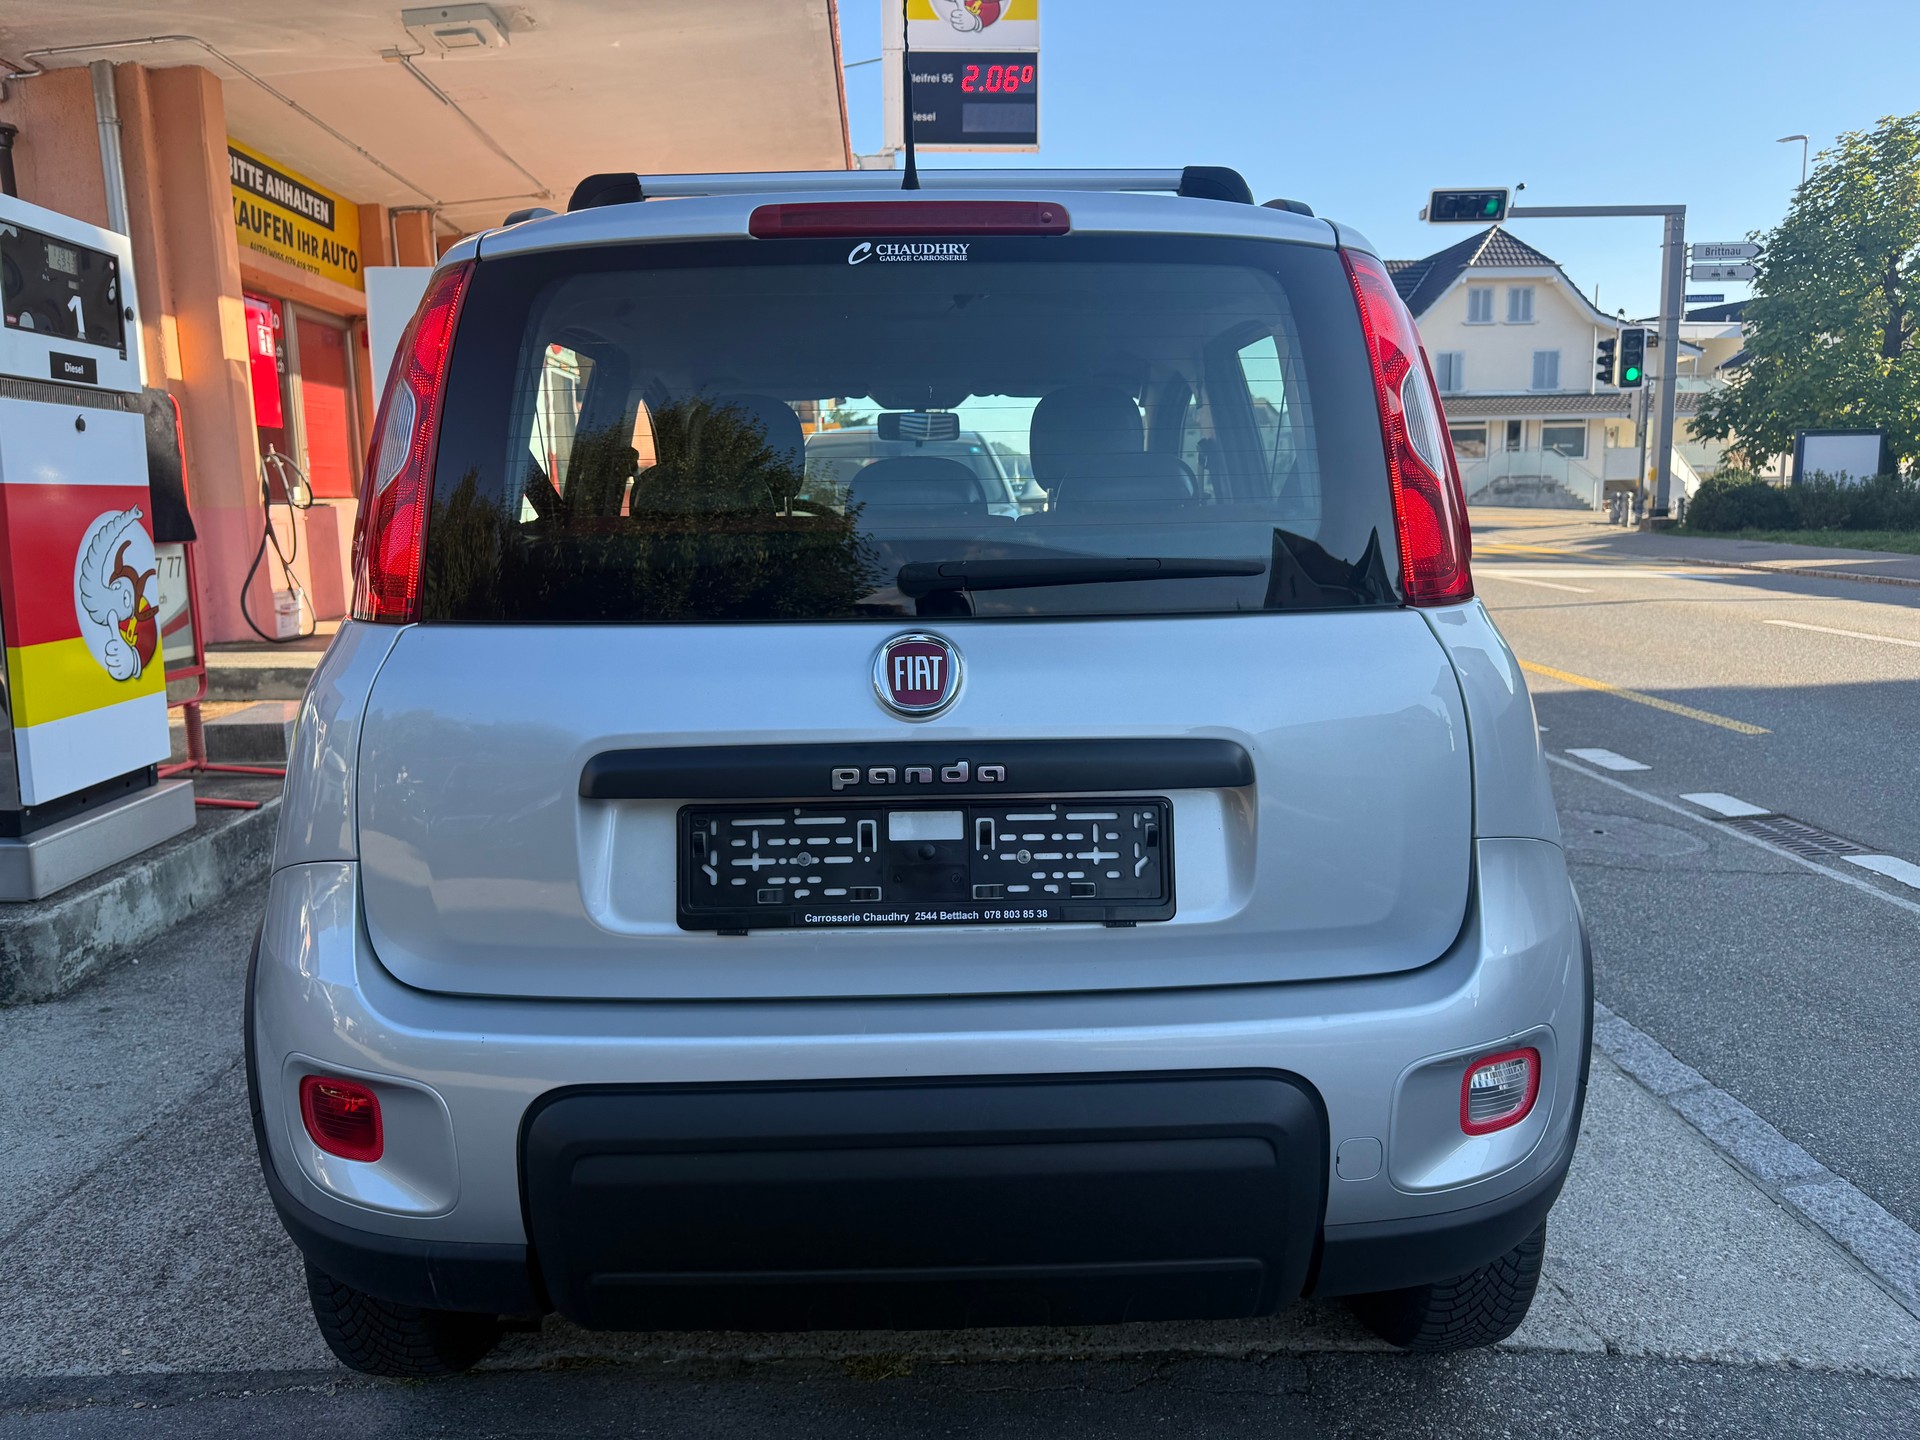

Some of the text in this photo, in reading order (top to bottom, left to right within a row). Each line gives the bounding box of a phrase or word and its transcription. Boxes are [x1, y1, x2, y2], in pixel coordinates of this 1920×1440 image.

[911, 73, 939, 84] leifrei
[942, 73, 954, 83] 95
[913, 112, 936, 122] iesel
[265, 173, 330, 224] ANHALTEN
[297, 229, 319, 259] IHR
[321, 238, 358, 274] AUTO
[876, 243, 970, 256] CHAUDHRY
[1705, 247, 1741, 257] Brittnau
[879, 254, 968, 262] GARAGE CARROSSERIE
[67, 295, 86, 340] 1
[64, 361, 84, 375] Diesel
[167, 556, 182, 578] 77
[894, 655, 943, 691] FIAT
[831, 761, 1005, 791] panda
[804, 909, 1048, 923] Carrosserie Chaudhry 2544 Bettlach 078 803 85 38
